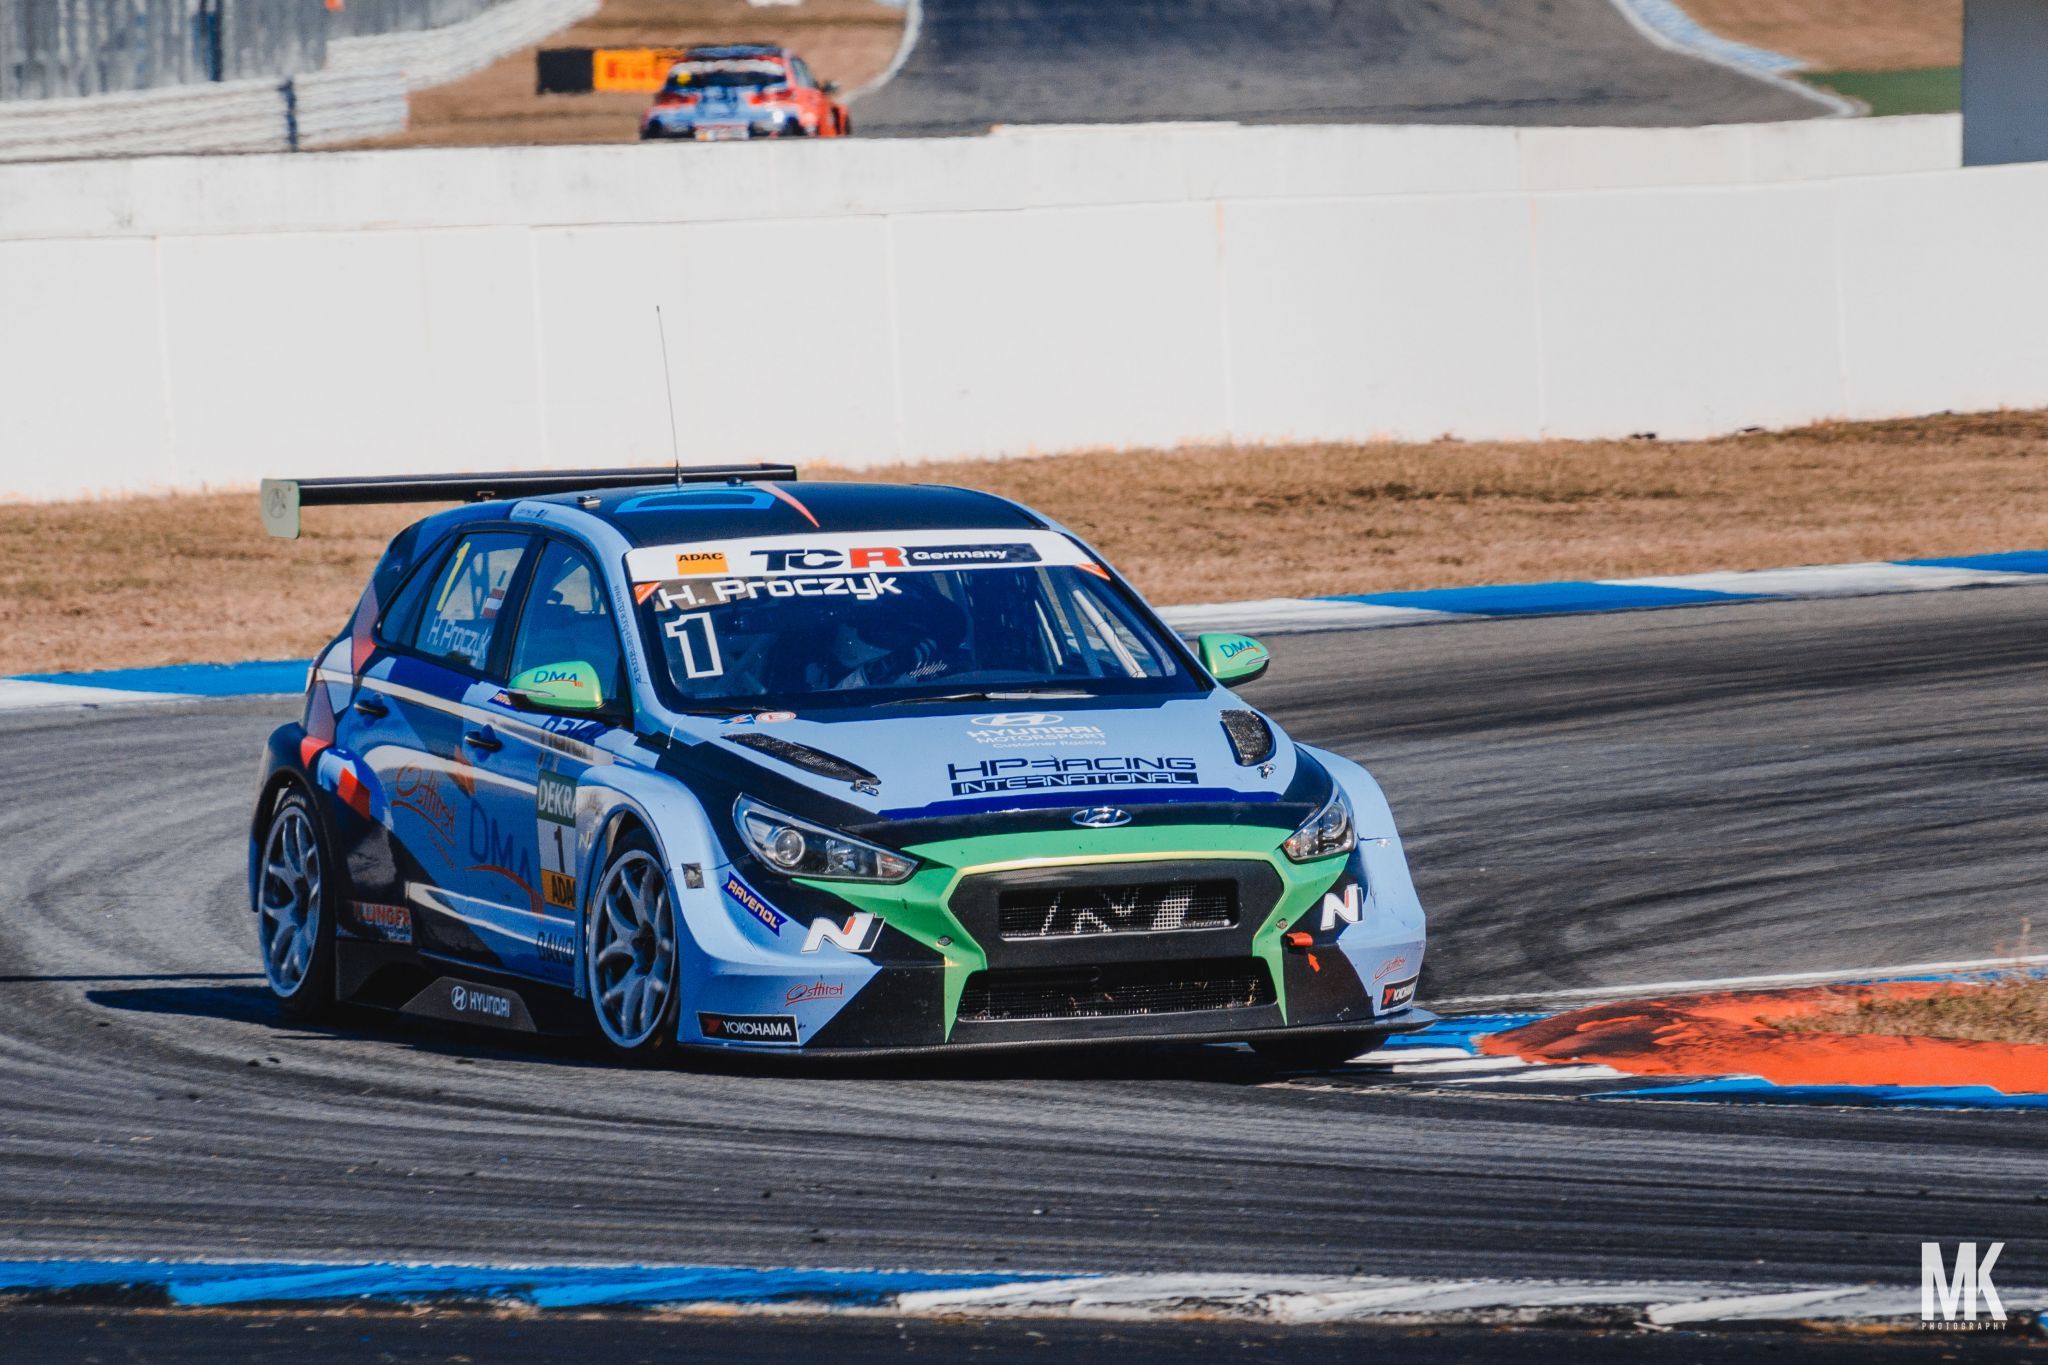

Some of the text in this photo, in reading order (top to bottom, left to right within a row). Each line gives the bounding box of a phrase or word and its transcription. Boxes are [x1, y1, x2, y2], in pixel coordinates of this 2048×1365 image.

[678, 552, 724, 562] ADAC
[750, 547, 1008, 571] TCR Germany
[658, 573, 902, 609] H. Proczyk
[664, 611, 724, 679] 1
[1220, 641, 1255, 658] DMA
[533, 671, 578, 683] DMA
[966, 726, 1103, 738] HYUNDAI
[976, 732, 1106, 744] MOTORSPORT
[960, 772, 1192, 794] INTERNATIONAL
[469, 799, 533, 891] DMA
[554, 825, 566, 873] 1
[727, 879, 779, 929] RAVENOL
[786, 981, 844, 1002] Osttirol
[469, 990, 511, 1018] HYUNDAI
[723, 1020, 792, 1037] YOKOHAMA
